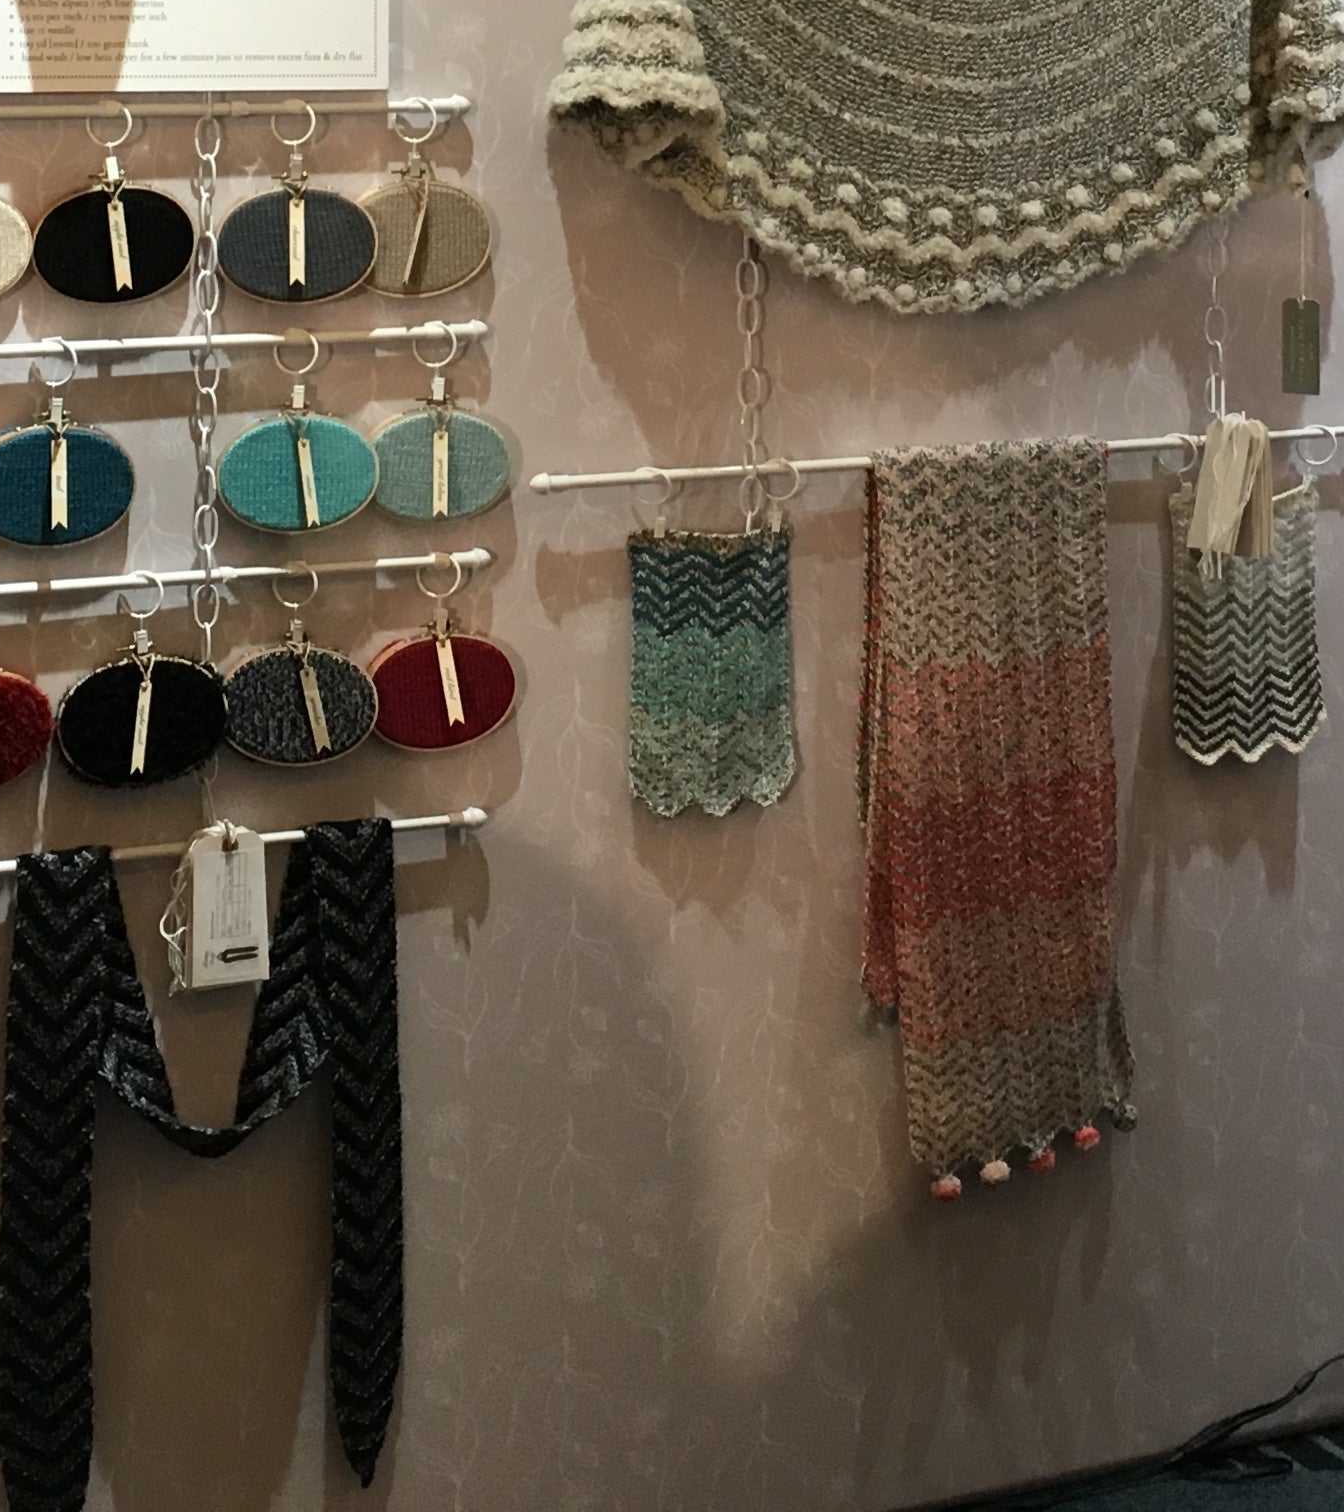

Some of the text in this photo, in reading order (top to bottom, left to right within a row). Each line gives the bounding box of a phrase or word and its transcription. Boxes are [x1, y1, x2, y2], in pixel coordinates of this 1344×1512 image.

[149, 10, 168, 21] inch
[162, 50, 178, 62] few
[332, 51, 347, 64] dry
